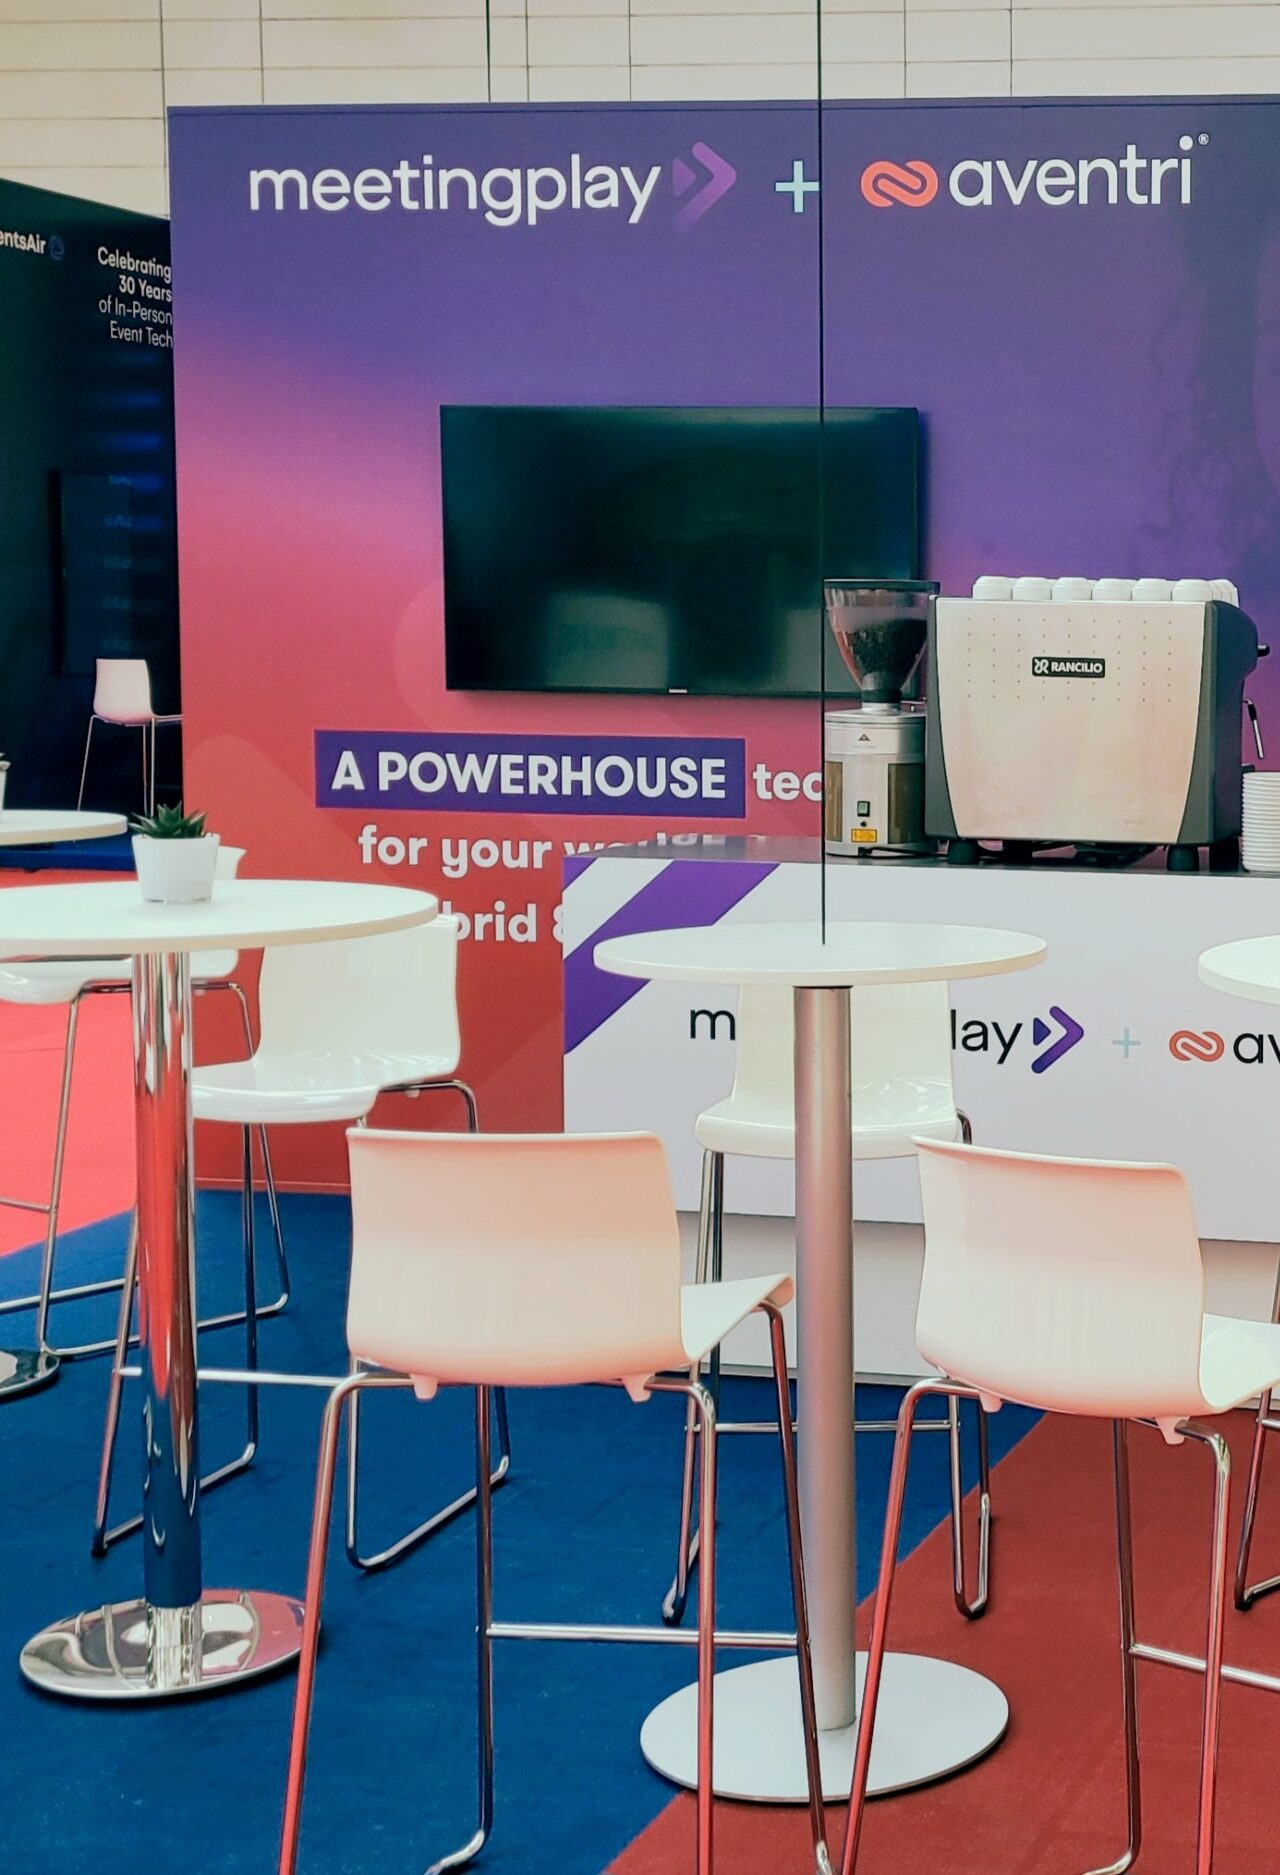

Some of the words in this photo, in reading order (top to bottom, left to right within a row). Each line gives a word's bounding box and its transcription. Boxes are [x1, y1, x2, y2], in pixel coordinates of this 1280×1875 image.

[249, 153, 662, 227] meetingplay
[97, 246, 172, 284] Celebrating
[118, 274, 136, 295] 30
[138, 278, 173, 303] Years
[98, 294, 112, 314] of
[115, 299, 172, 325] In-Person
[110, 320, 143, 343] Event
[146, 326, 173, 349] Tech
[1050, 661, 1103, 674] RANCILIO
[330, 750, 365, 791] A
[377, 750, 727, 800] POWERHOUSE
[752, 763, 823, 802] tec
[358, 824, 428, 866] for
[441, 836, 553, 879] your
[442, 899, 537, 943] brid
